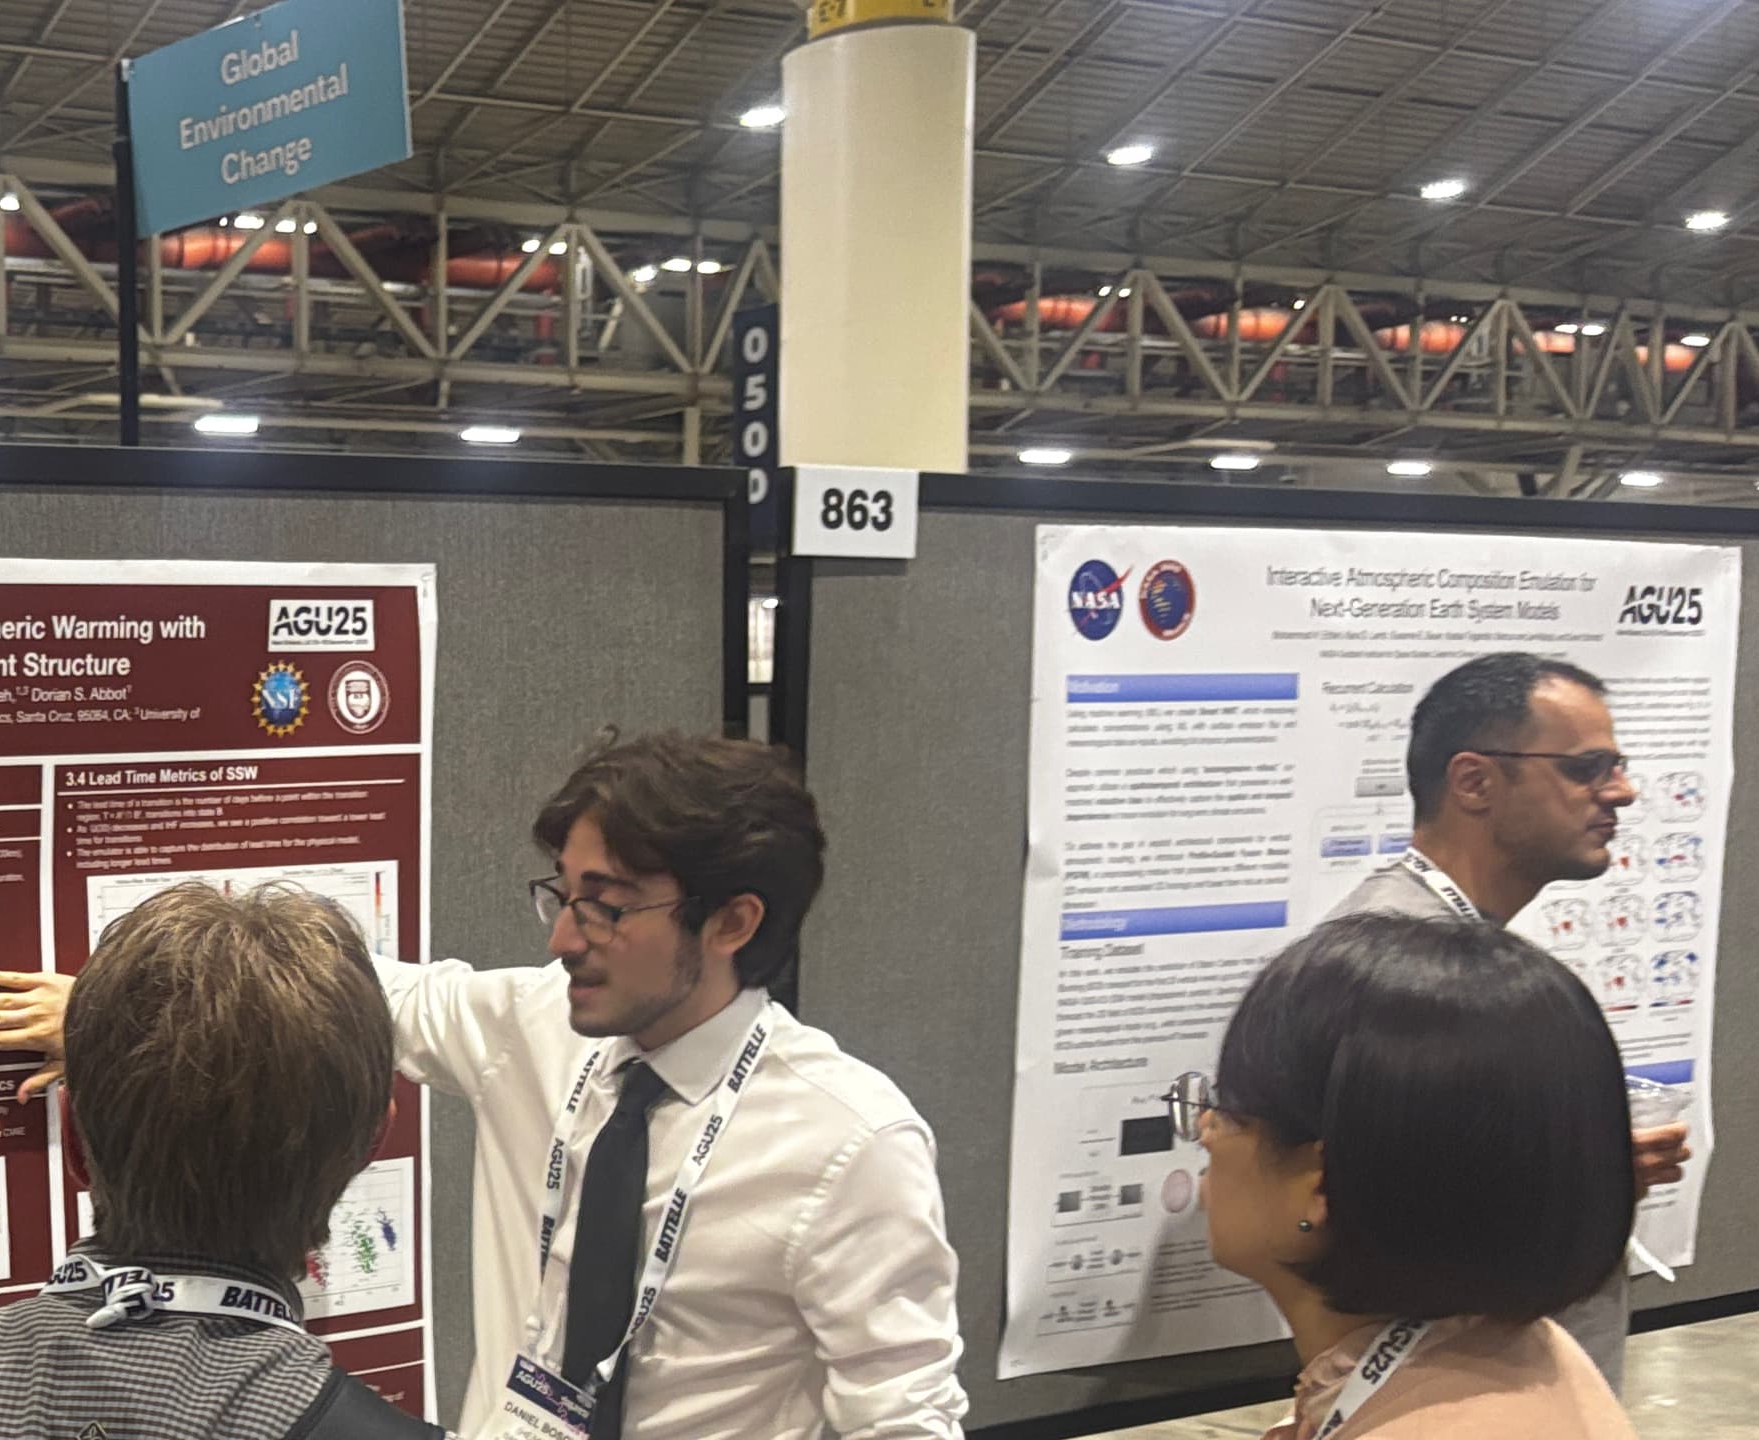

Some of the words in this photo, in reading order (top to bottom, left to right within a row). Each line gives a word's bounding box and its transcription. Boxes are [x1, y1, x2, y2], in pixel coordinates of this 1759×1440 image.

[220, 29, 300, 86] Global
[179, 62, 349, 151] Environmental
[220, 136, 313, 185] Change
[820, 487, 894, 532] 863
[1071, 591, 1121, 609] NASA
[1618, 585, 1703, 625] AGU25
[51, 615, 154, 645] Warming
[159, 614, 206, 639] with
[272, 606, 368, 636] AGU25
[22, 652, 131, 680] Structure
[31, 688, 71, 702] Dorian
[74, 688, 86, 701] S.
[17, 711, 46, 723] Santa
[190, 707, 201, 719] of
[65, 771, 87, 787] 3.4
[89, 770, 122, 787] Lead
[125, 769, 156, 784] Time
[159, 767, 207, 783] Metrics
[209, 767, 225, 782] of
[226, 766, 259, 781] SSW
[655, 1187, 687, 1263] BATTELLE
[692, 1114, 723, 1166] AGU25
[727, 1023, 767, 1093] BATTELLE
[546, 1137, 565, 1190] AGU25
[504, 1401, 540, 1429] DANIEL
